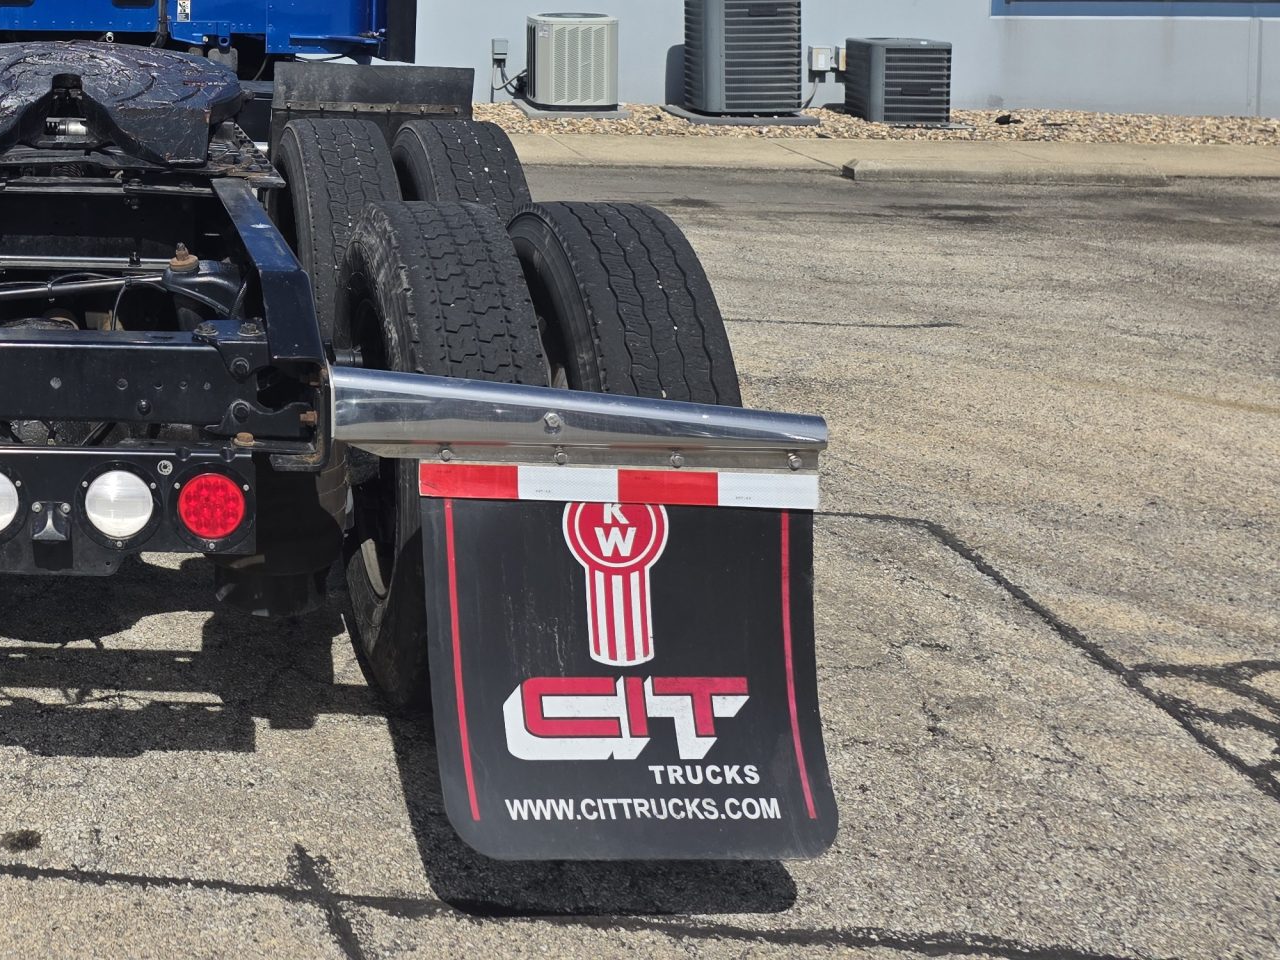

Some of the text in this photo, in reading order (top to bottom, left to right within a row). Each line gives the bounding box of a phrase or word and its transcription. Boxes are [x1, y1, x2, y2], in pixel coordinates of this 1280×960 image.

[503, 676, 750, 760] CIT
[648, 764, 761, 785] TRUCKS
[504, 798, 782, 821] WWW.CITTRUCKS.COM
